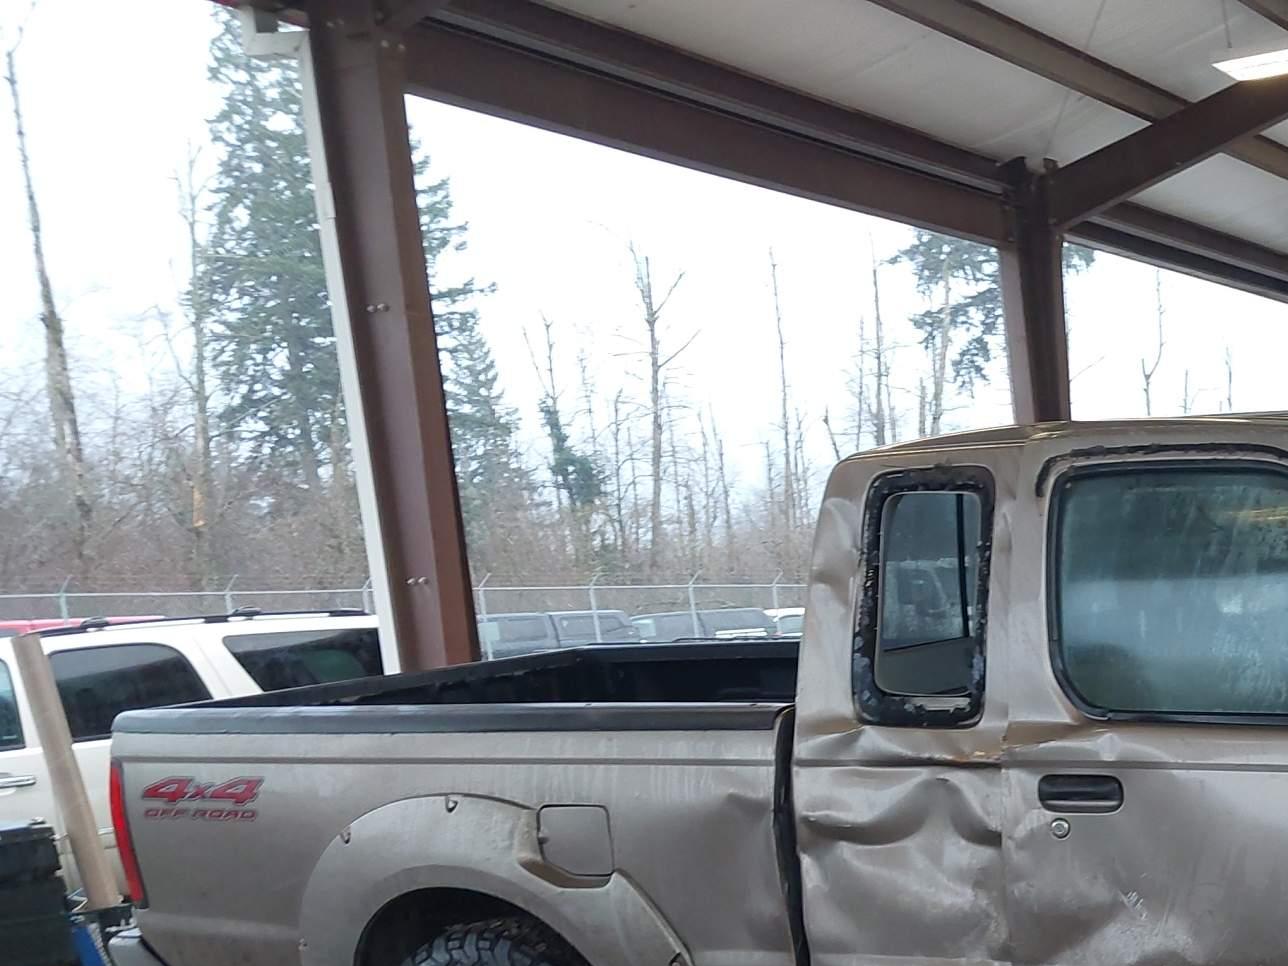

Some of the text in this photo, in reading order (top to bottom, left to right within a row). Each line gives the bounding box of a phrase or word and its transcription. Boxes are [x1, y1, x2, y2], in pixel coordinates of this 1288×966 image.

[142, 776, 264, 806] 4x4
[143, 807, 258, 821] OFF ROAD
